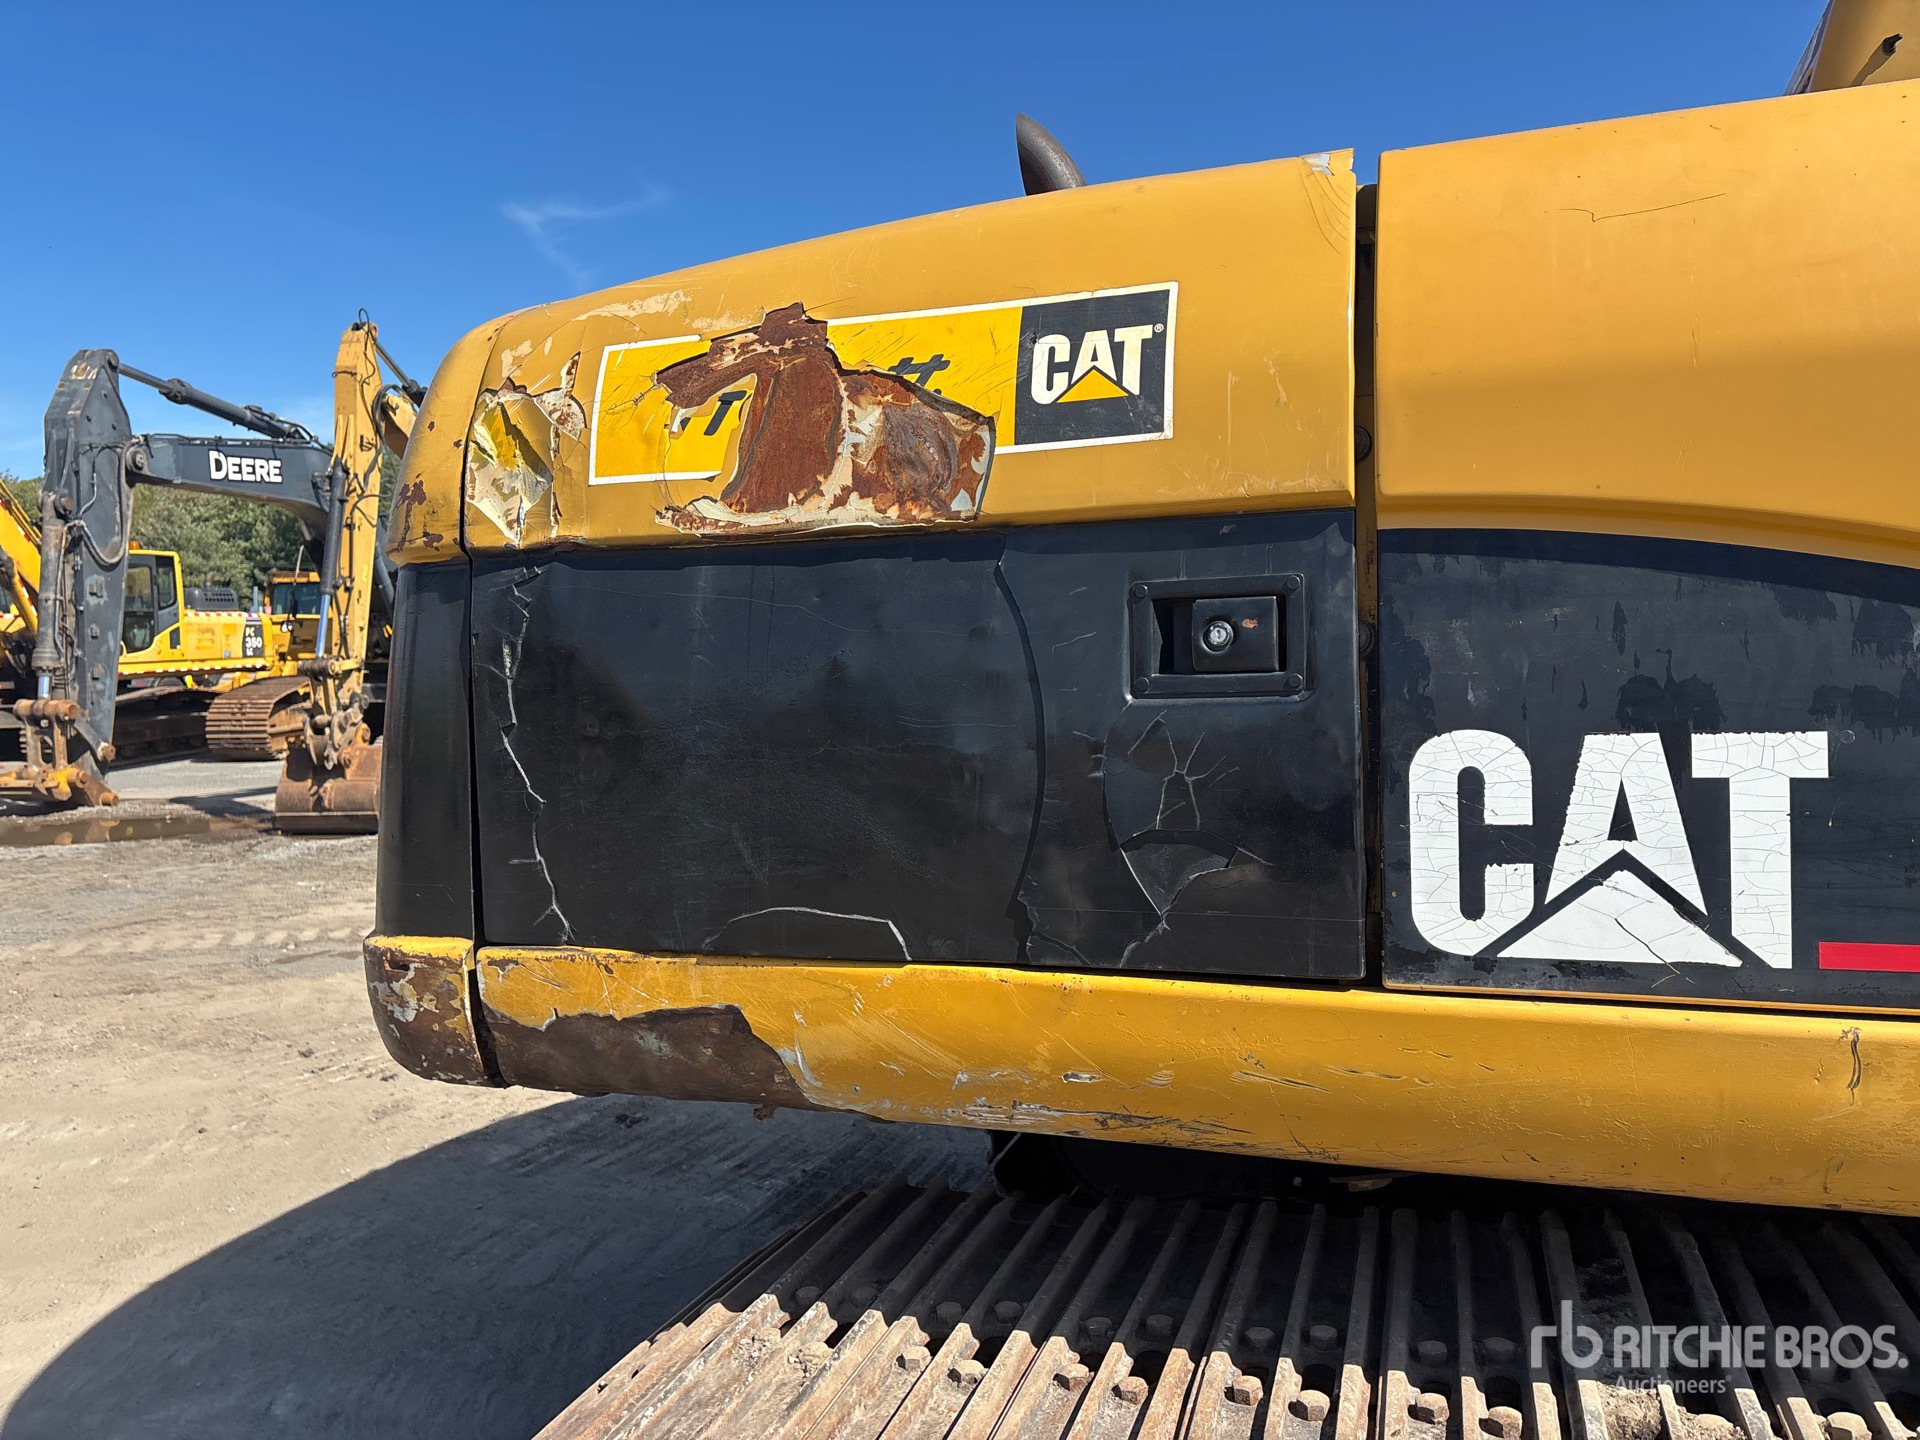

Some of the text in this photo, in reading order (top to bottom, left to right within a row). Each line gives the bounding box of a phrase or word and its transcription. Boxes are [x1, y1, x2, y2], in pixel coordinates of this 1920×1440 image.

[208, 449, 283, 483] DEERE
[245, 636, 263, 648] 350
[1408, 729, 1829, 969] CAT
